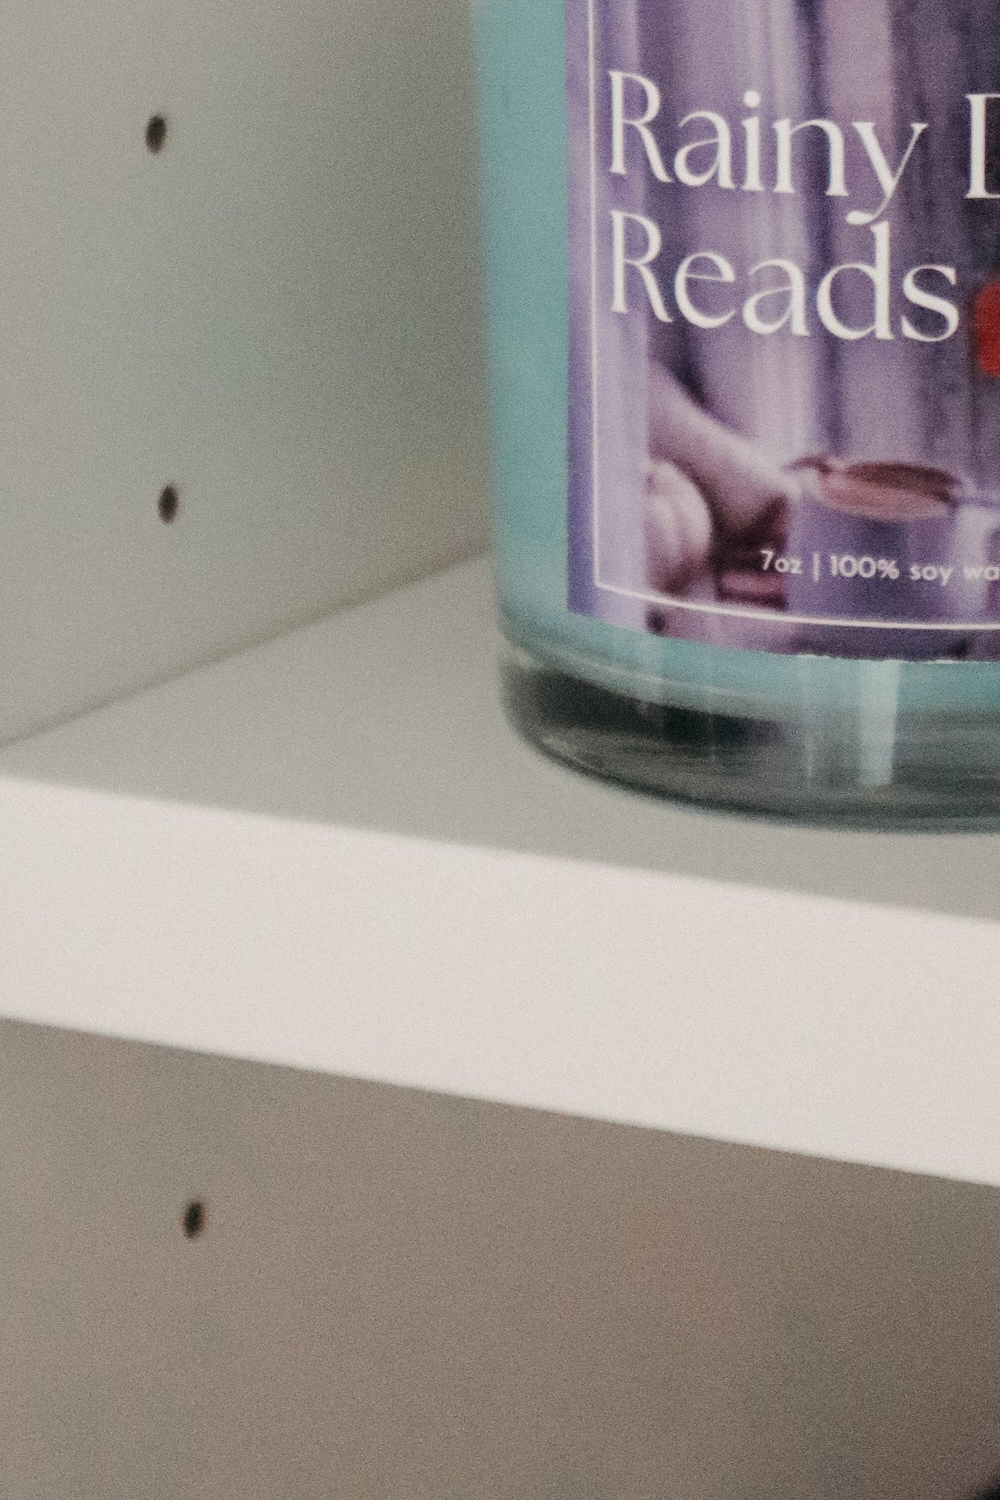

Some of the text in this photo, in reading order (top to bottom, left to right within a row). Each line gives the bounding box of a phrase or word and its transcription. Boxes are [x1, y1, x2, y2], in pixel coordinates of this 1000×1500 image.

[608, 69, 928, 225] Rainy
[609, 209, 960, 342] Reads
[761, 549, 802, 575] 7oz
[829, 553, 900, 580] 100%
[909, 563, 952, 587] soy
